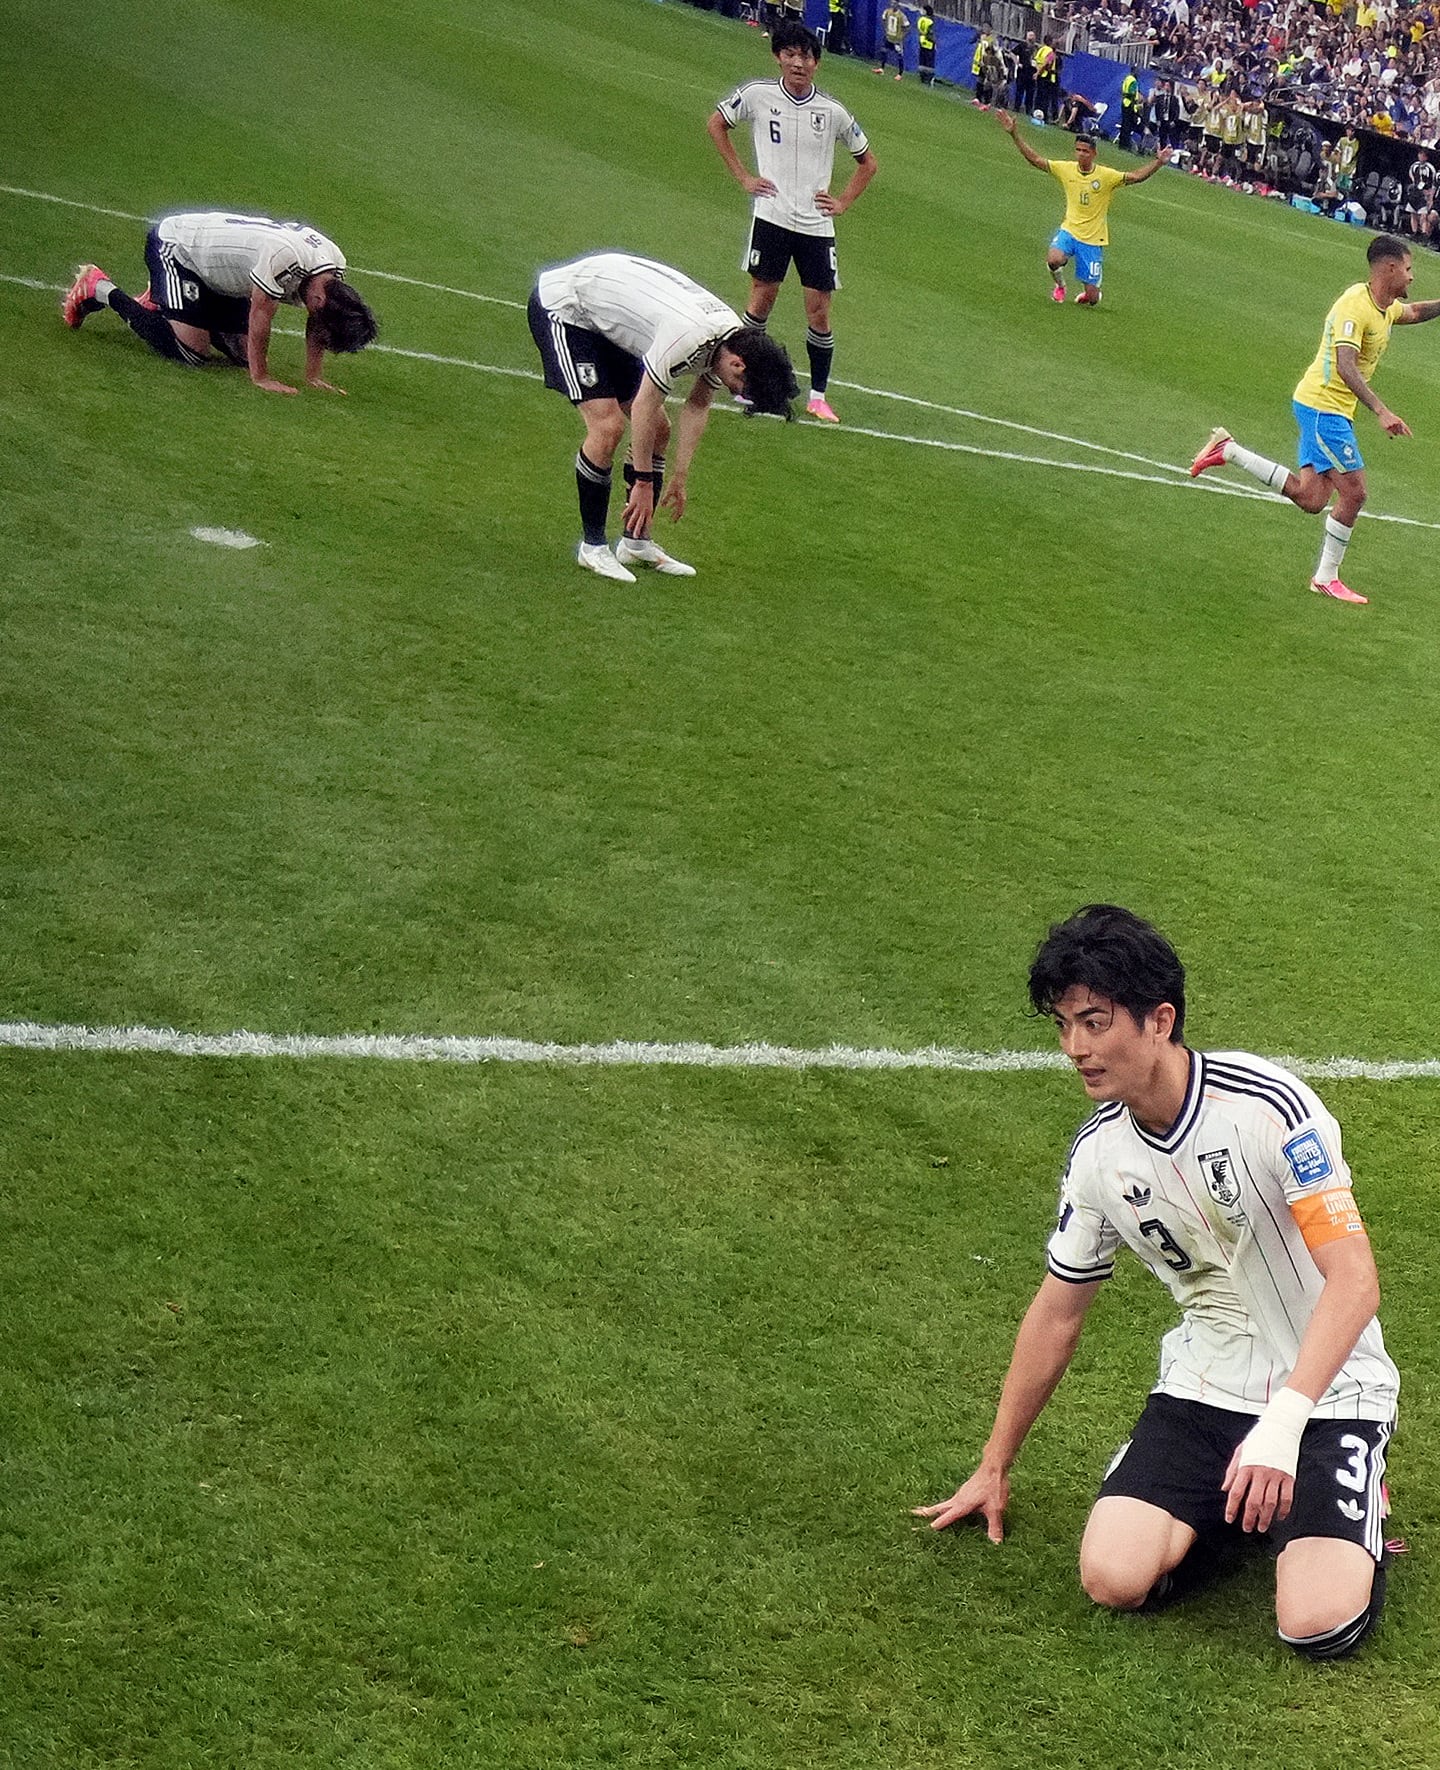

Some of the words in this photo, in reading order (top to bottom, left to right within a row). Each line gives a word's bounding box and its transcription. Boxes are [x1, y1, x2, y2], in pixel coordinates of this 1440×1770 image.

[769, 120, 781, 143] 6
[1089, 261, 1100, 276] 16
[1326, 1200, 1358, 1215] UNITE
[1139, 1218, 1192, 1271] 3
[1336, 1433, 1369, 1494] 3
